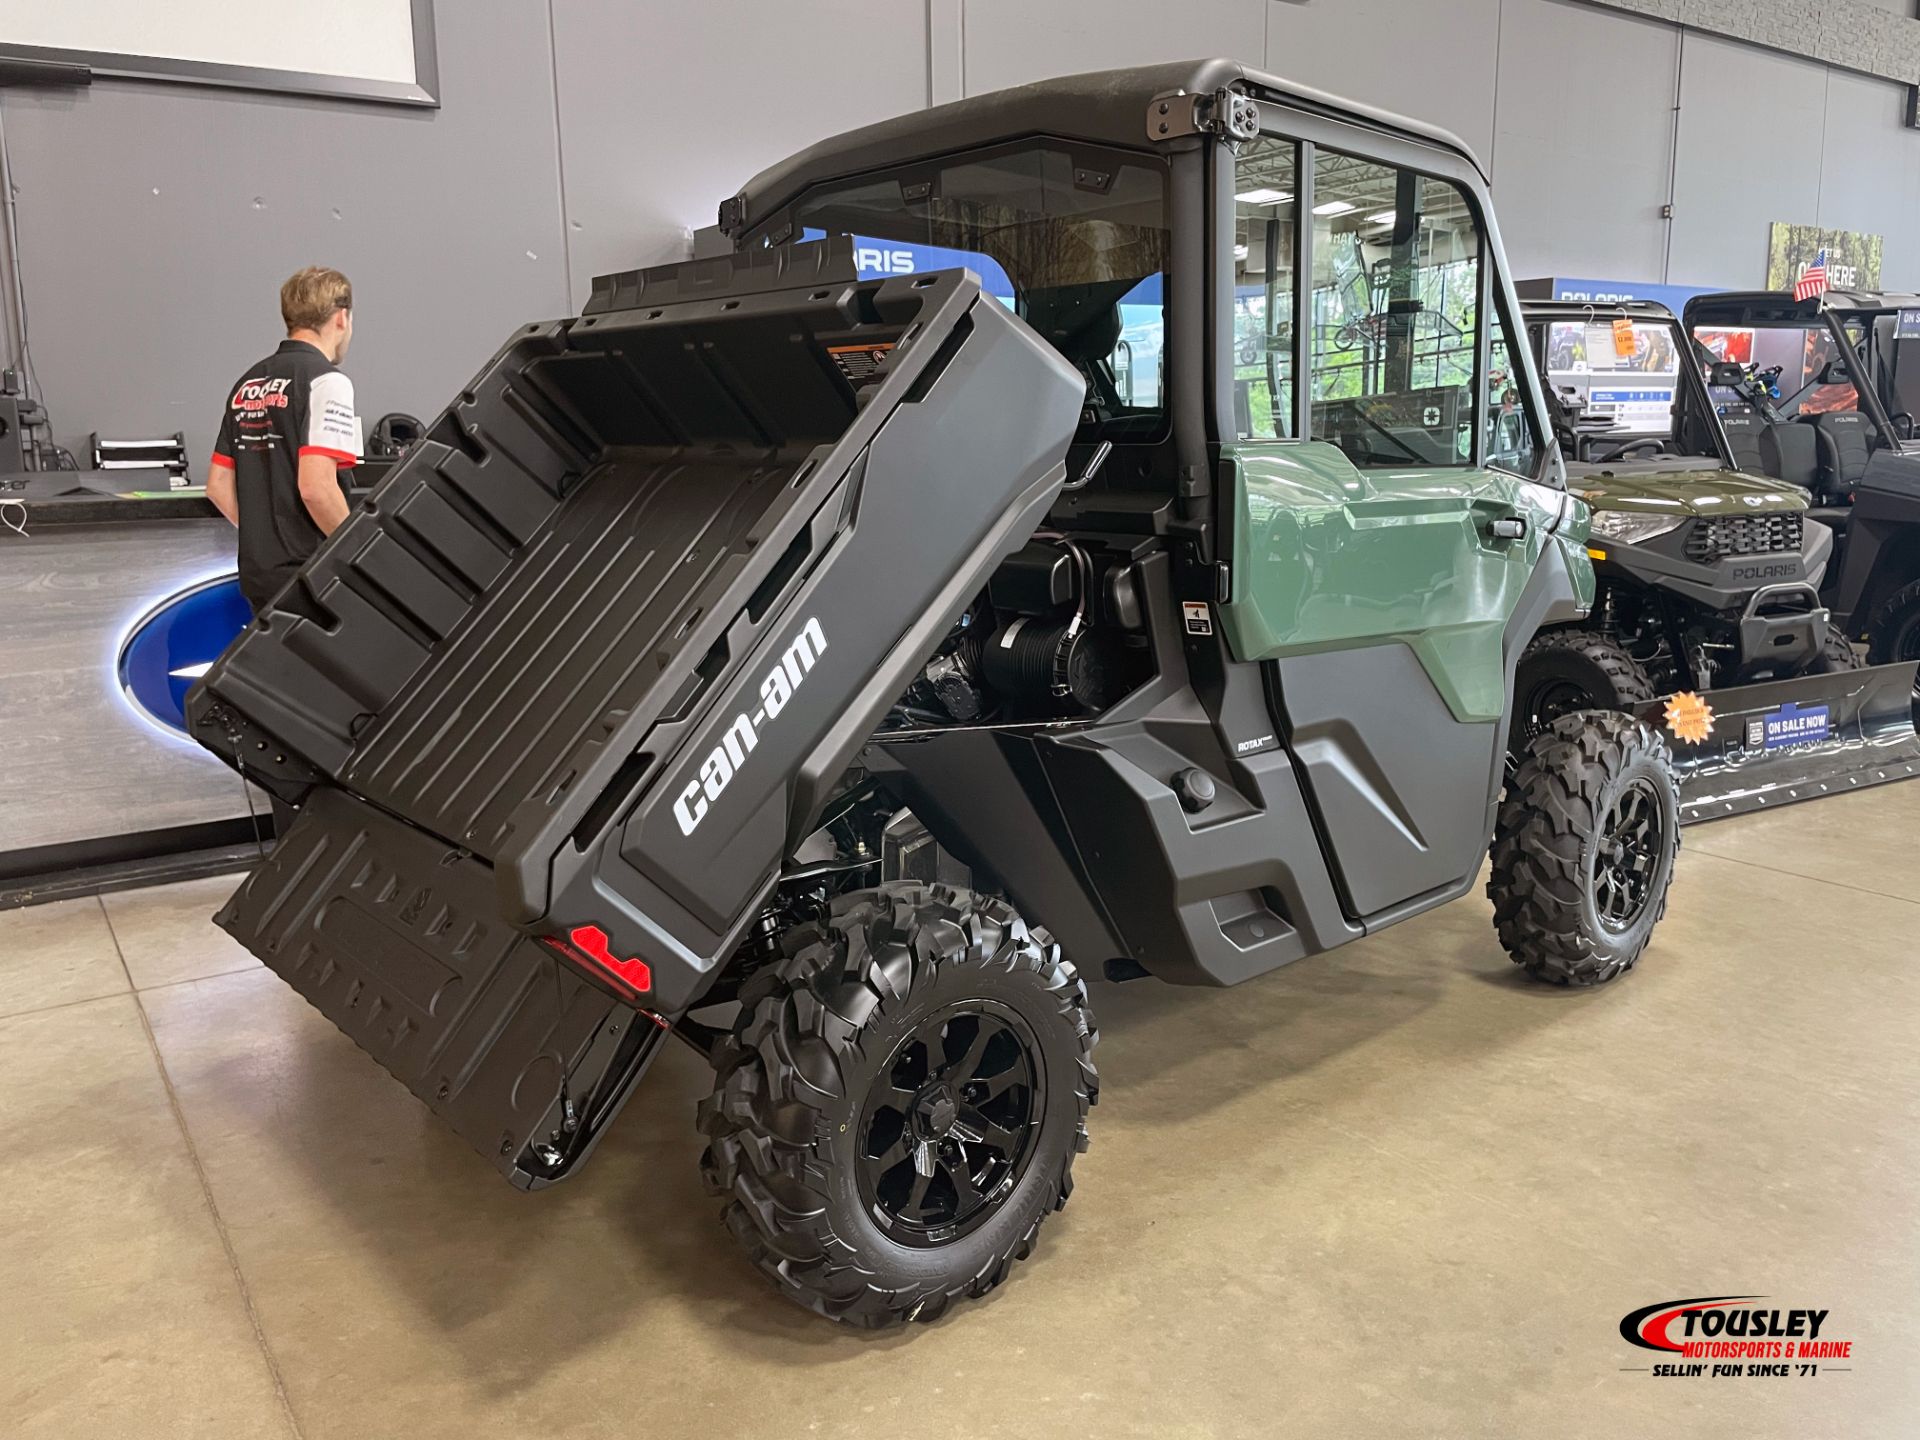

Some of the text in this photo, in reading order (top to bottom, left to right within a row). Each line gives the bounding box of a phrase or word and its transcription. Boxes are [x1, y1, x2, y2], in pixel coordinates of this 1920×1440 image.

[1826, 264, 1857, 287] HERE
[1732, 563, 1797, 581] POLARIS
[673, 616, 828, 837] can-am
[1768, 721, 1781, 735] ON
[1782, 717, 1805, 733] SALE
[1806, 714, 1827, 729] NOW
[1237, 737, 1263, 753] ROTAX
